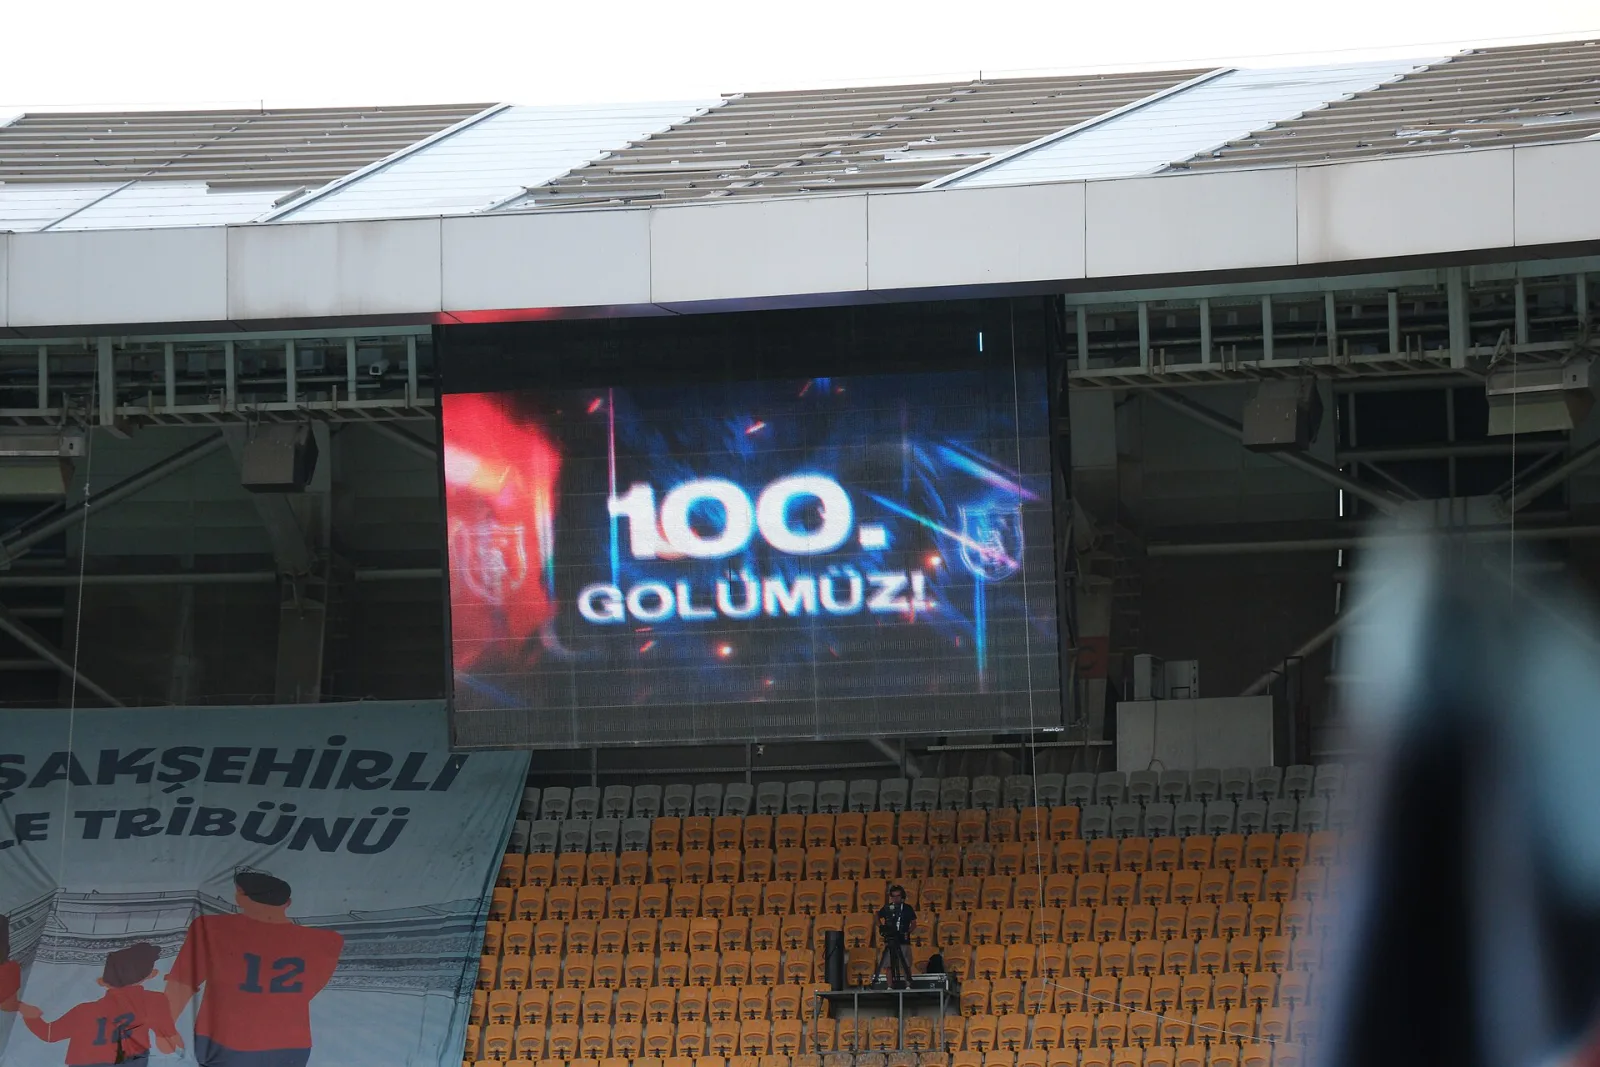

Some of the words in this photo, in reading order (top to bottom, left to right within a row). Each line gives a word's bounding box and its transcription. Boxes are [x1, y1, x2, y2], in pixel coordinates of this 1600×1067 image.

[608, 475, 886, 559] 100.
[578, 566, 930, 622] GOLÜMÜZ!
[73, 797, 411, 855] TRİBÜNÜ
[238, 952, 305, 994] 12
[92, 1012, 135, 1046] 12
